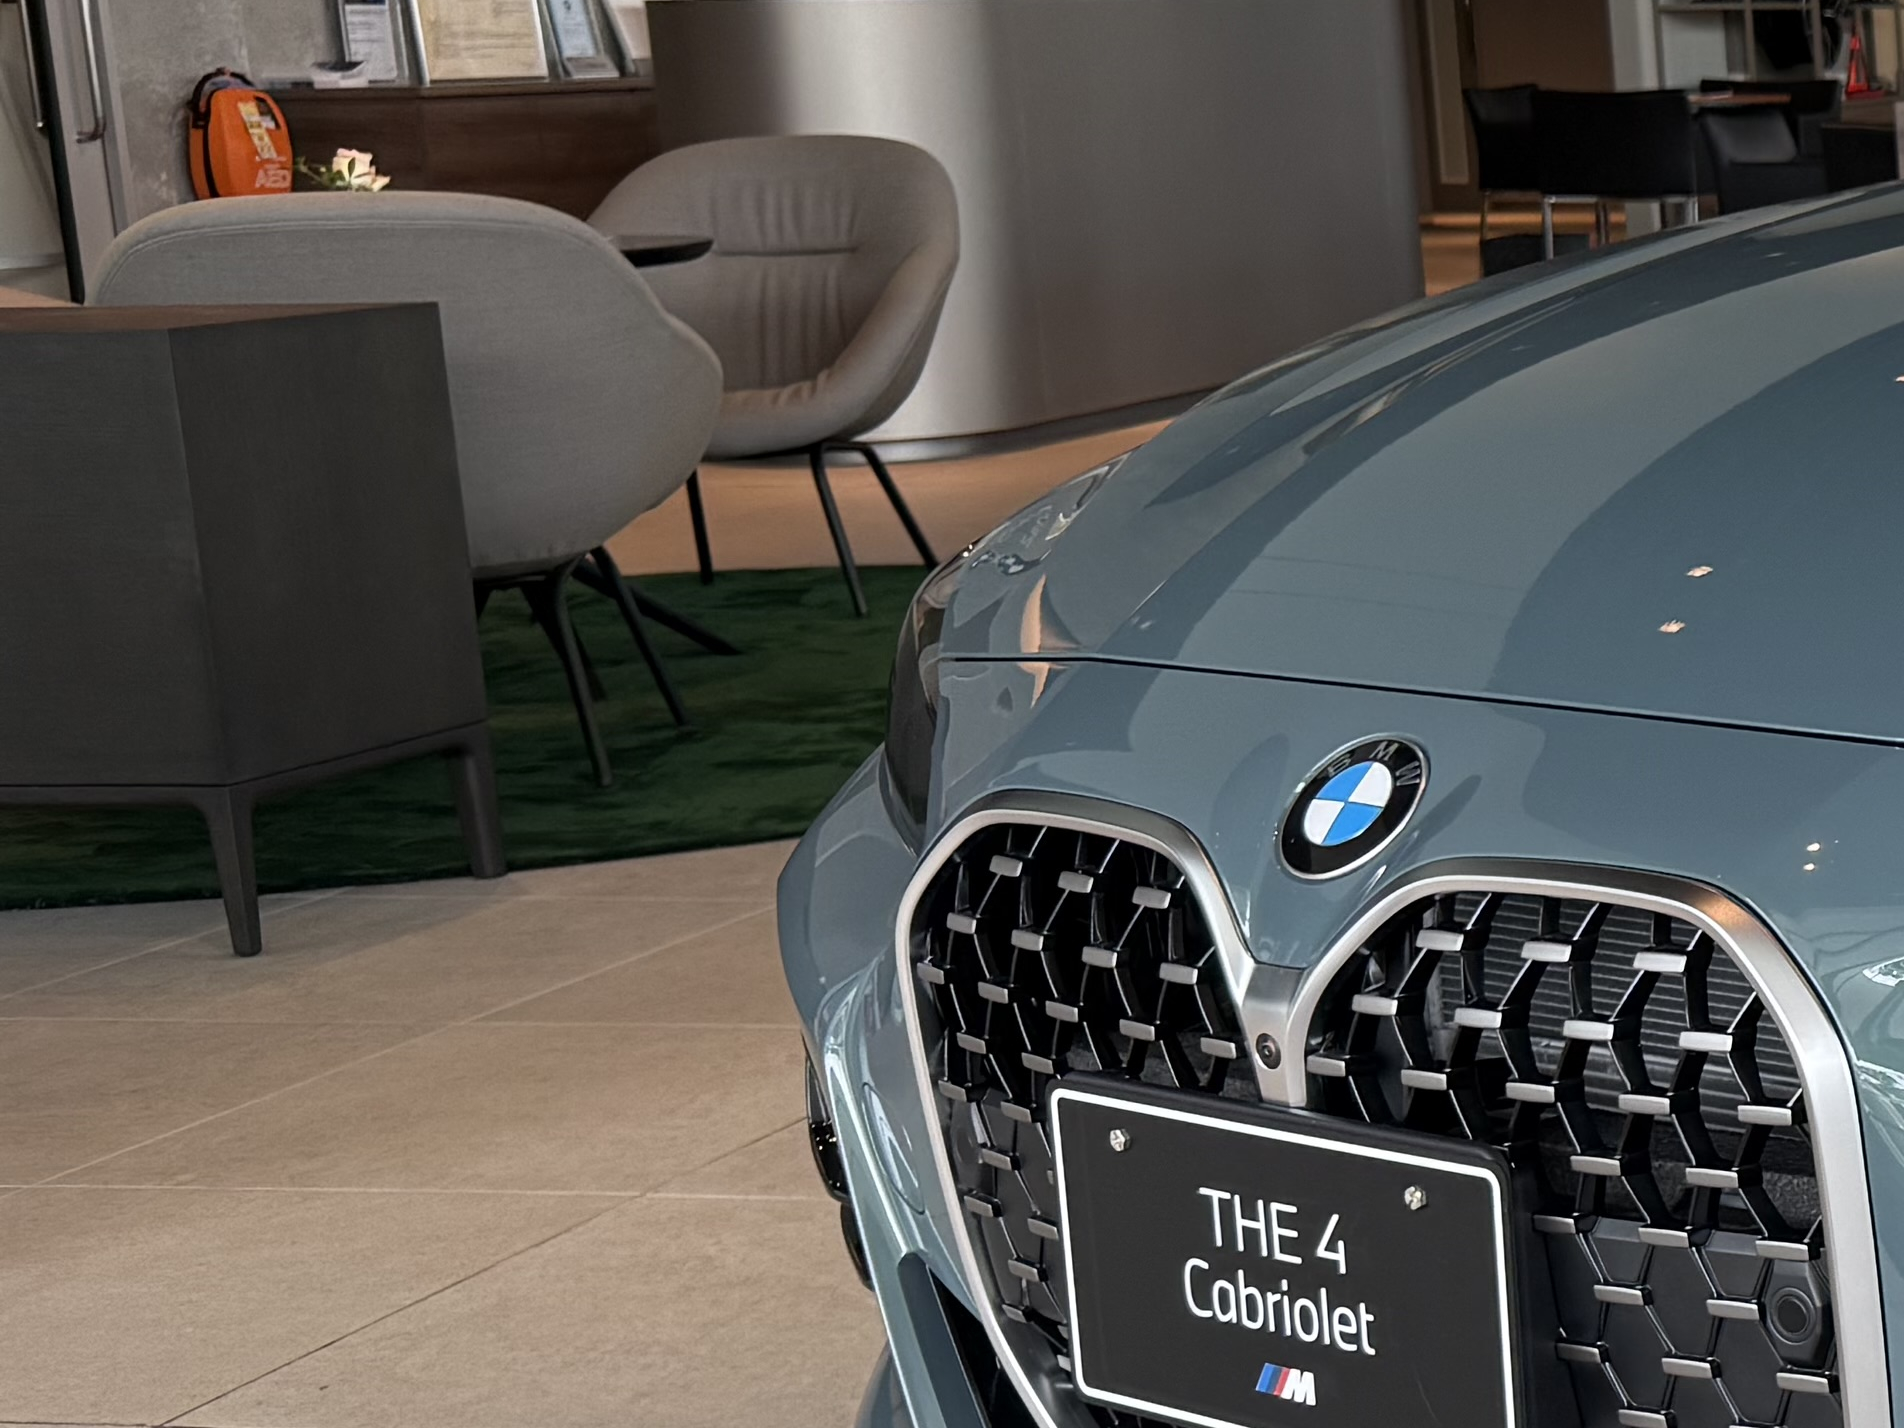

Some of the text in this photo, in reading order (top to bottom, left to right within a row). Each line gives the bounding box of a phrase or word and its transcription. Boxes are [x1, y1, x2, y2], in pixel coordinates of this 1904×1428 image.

[1197, 1187, 1347, 1274] THE 4
[1183, 1257, 1376, 1356] Cabriolet
[1279, 1367, 1317, 1407] M
